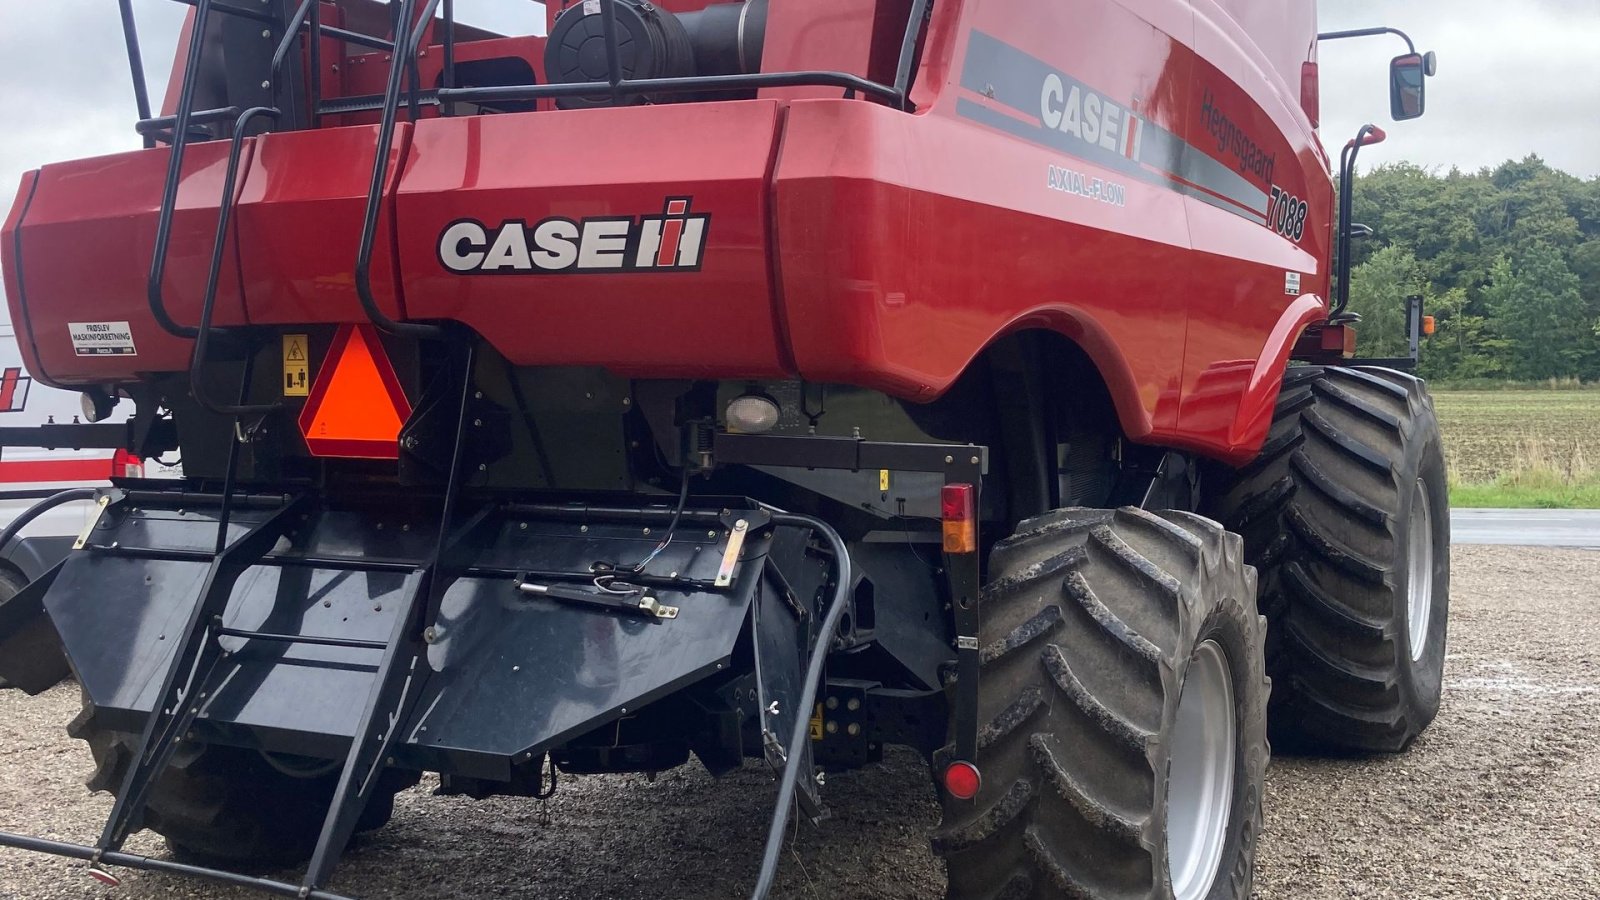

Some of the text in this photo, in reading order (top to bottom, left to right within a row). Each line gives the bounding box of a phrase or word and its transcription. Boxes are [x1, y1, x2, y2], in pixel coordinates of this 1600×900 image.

[1041, 73, 1120, 152] CASE
[1200, 87, 1276, 184] Hegnsgaard
[1047, 164, 1125, 207] AXIAL-FLOW
[1268, 184, 1308, 242] 7088
[439, 219, 631, 271] CASE
[72, 332, 131, 341] MASKINFORRETNING
[86, 324, 110, 332] FRØSLEV
